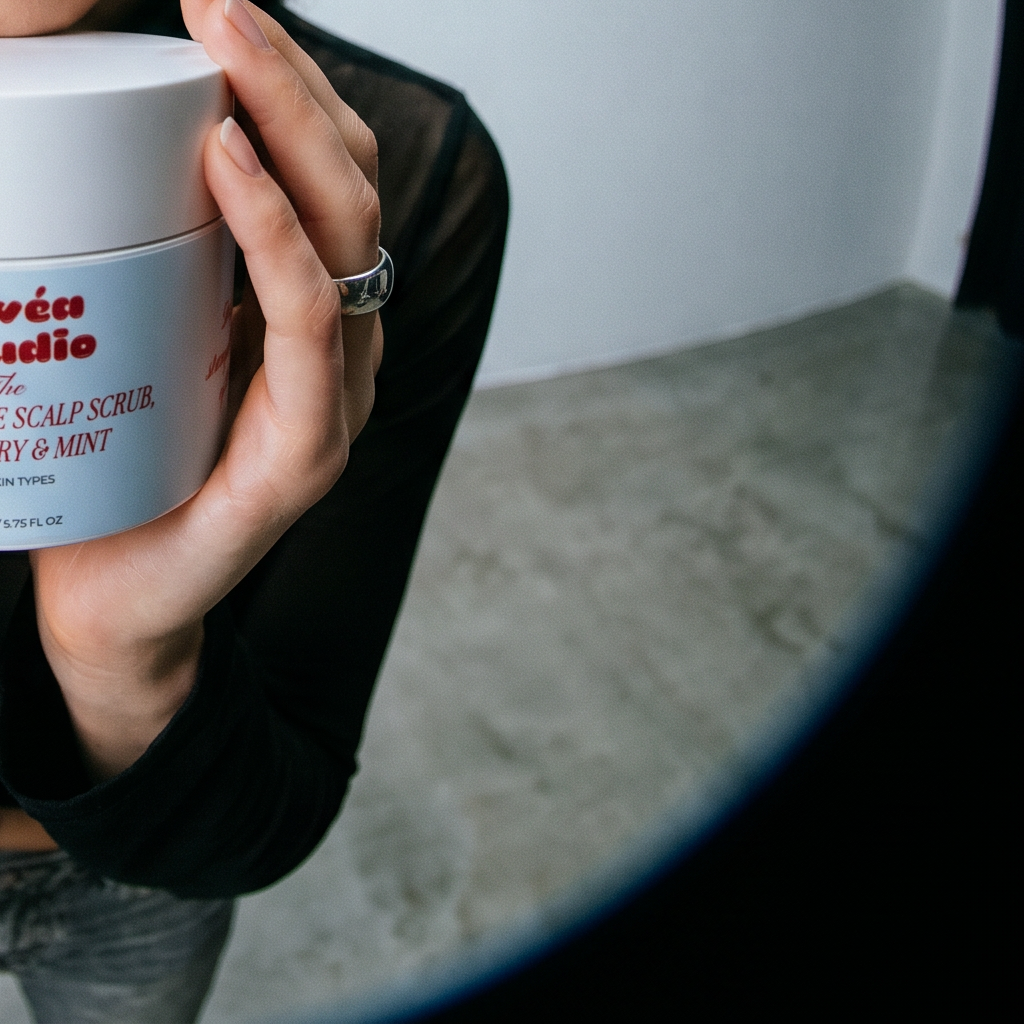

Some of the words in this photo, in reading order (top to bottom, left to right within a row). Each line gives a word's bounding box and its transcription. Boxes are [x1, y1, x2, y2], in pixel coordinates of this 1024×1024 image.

[12, 400, 84, 429] SCALP
[86, 384, 156, 422] SCRUB,
[31, 437, 50, 461] &
[52, 427, 114, 460] MINT
[16, 474, 56, 487] TYPES
[3, 518, 28, 530] 5.75
[29, 517, 44, 528] FL
[45, 515, 64, 527] OZ
